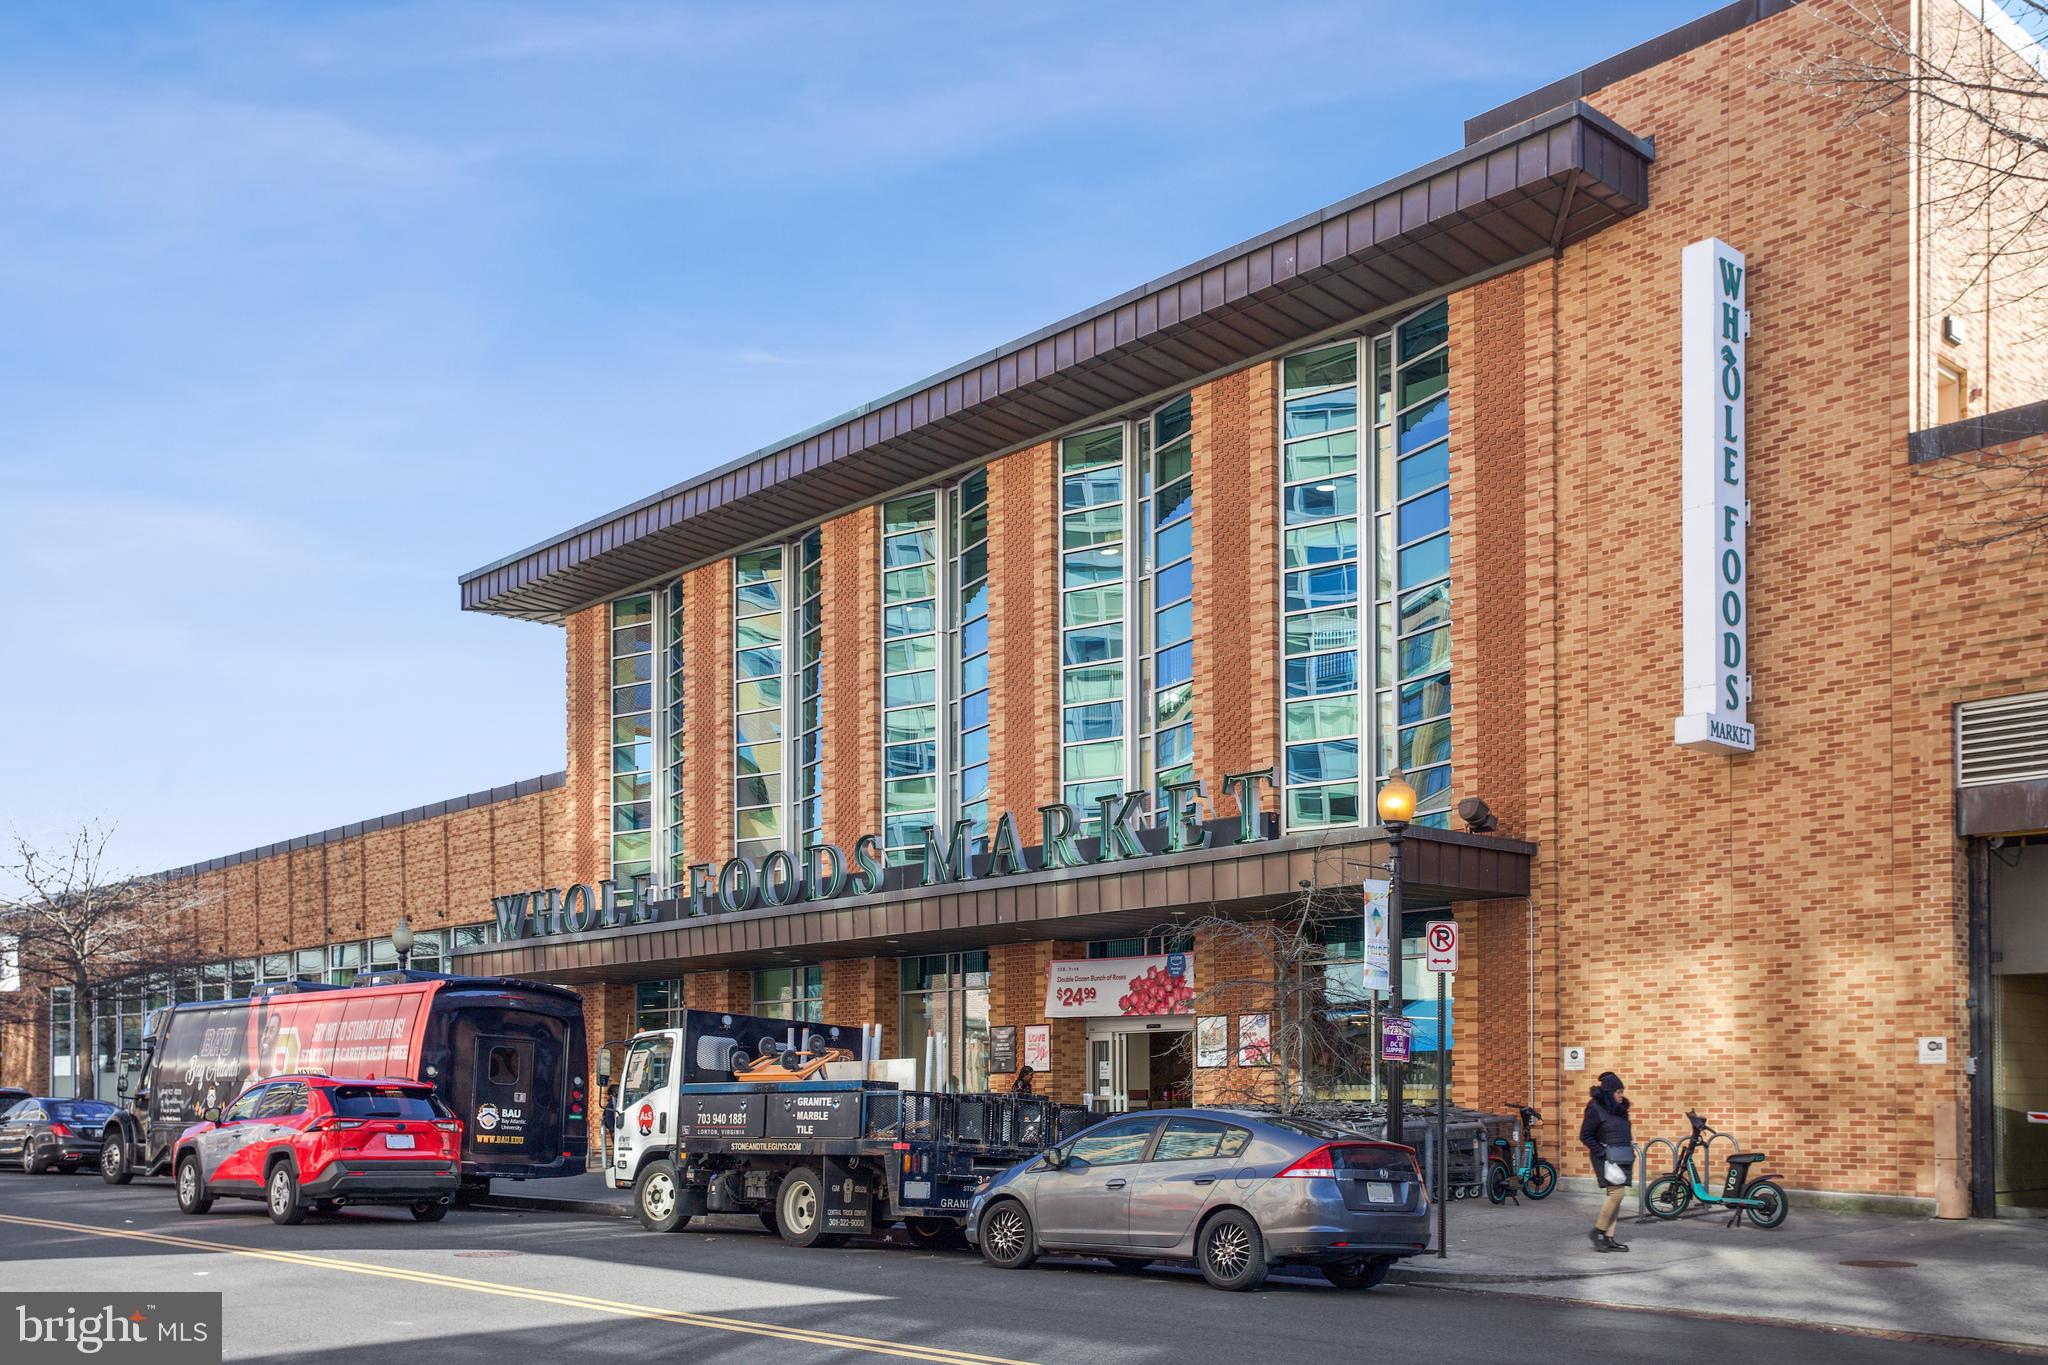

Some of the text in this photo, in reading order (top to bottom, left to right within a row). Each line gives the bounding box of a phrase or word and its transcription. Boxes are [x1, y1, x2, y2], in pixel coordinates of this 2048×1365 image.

[1718, 256, 1743, 486] WHOLE
[1721, 505, 1742, 710] FOODS
[1710, 719, 1752, 745] MARKET
[490, 766, 1281, 942] WHOLE FOODS MARKET
[347, 1019, 380, 1040] STUDENT
[798, 1097, 832, 1107] GRANITE
[502, 1108, 521, 1118] BAU
[640, 1111, 652, 1120] A&S
[697, 1112, 747, 1125] 703 940 1881
[796, 1111, 829, 1121] MARBLE
[697, 1128, 720, 1136] LORTON,
[796, 1125, 814, 1135] TILE
[730, 1142, 802, 1152] STONEANDTILEGUYS.COM
[1727, 1169, 1738, 1191] veo
